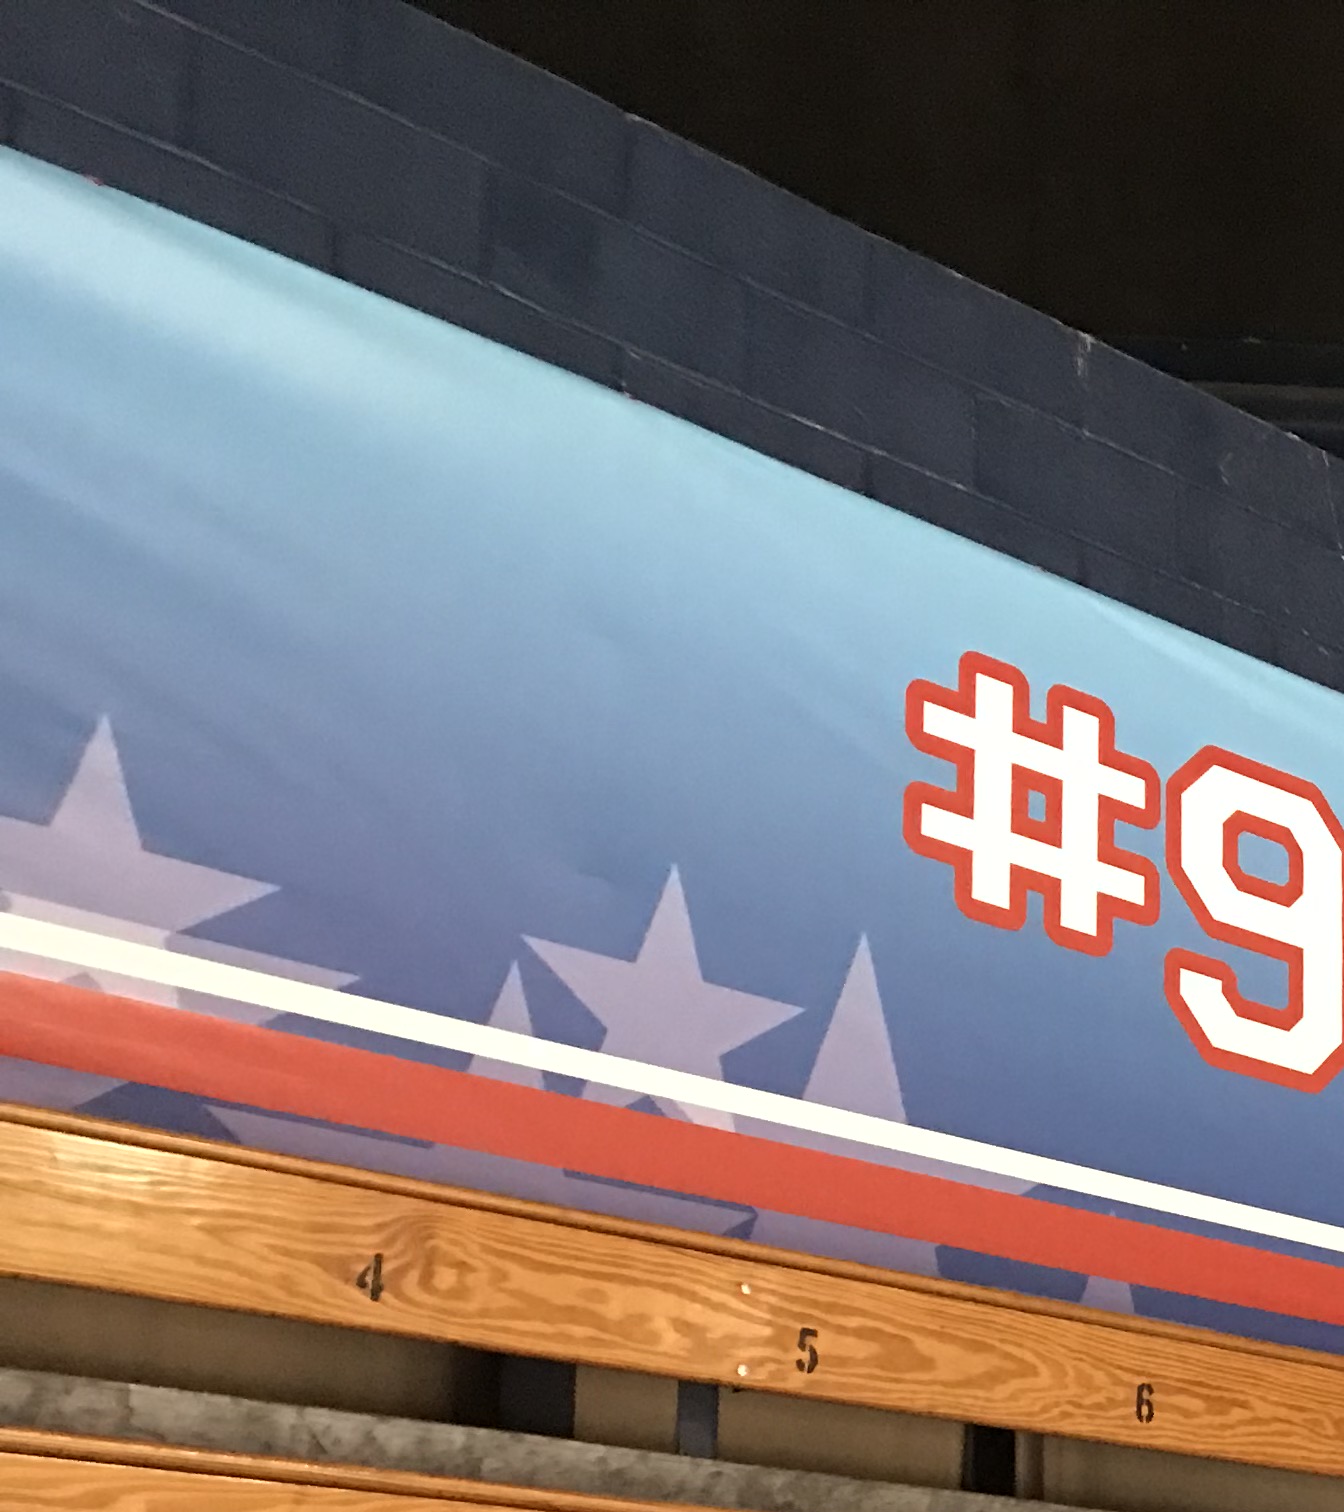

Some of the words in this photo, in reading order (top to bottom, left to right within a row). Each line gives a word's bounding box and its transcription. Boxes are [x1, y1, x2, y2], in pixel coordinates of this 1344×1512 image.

[355, 1251, 386, 1302] 4
[794, 1326, 820, 1375] 5
[1135, 1381, 1156, 1424] 6
